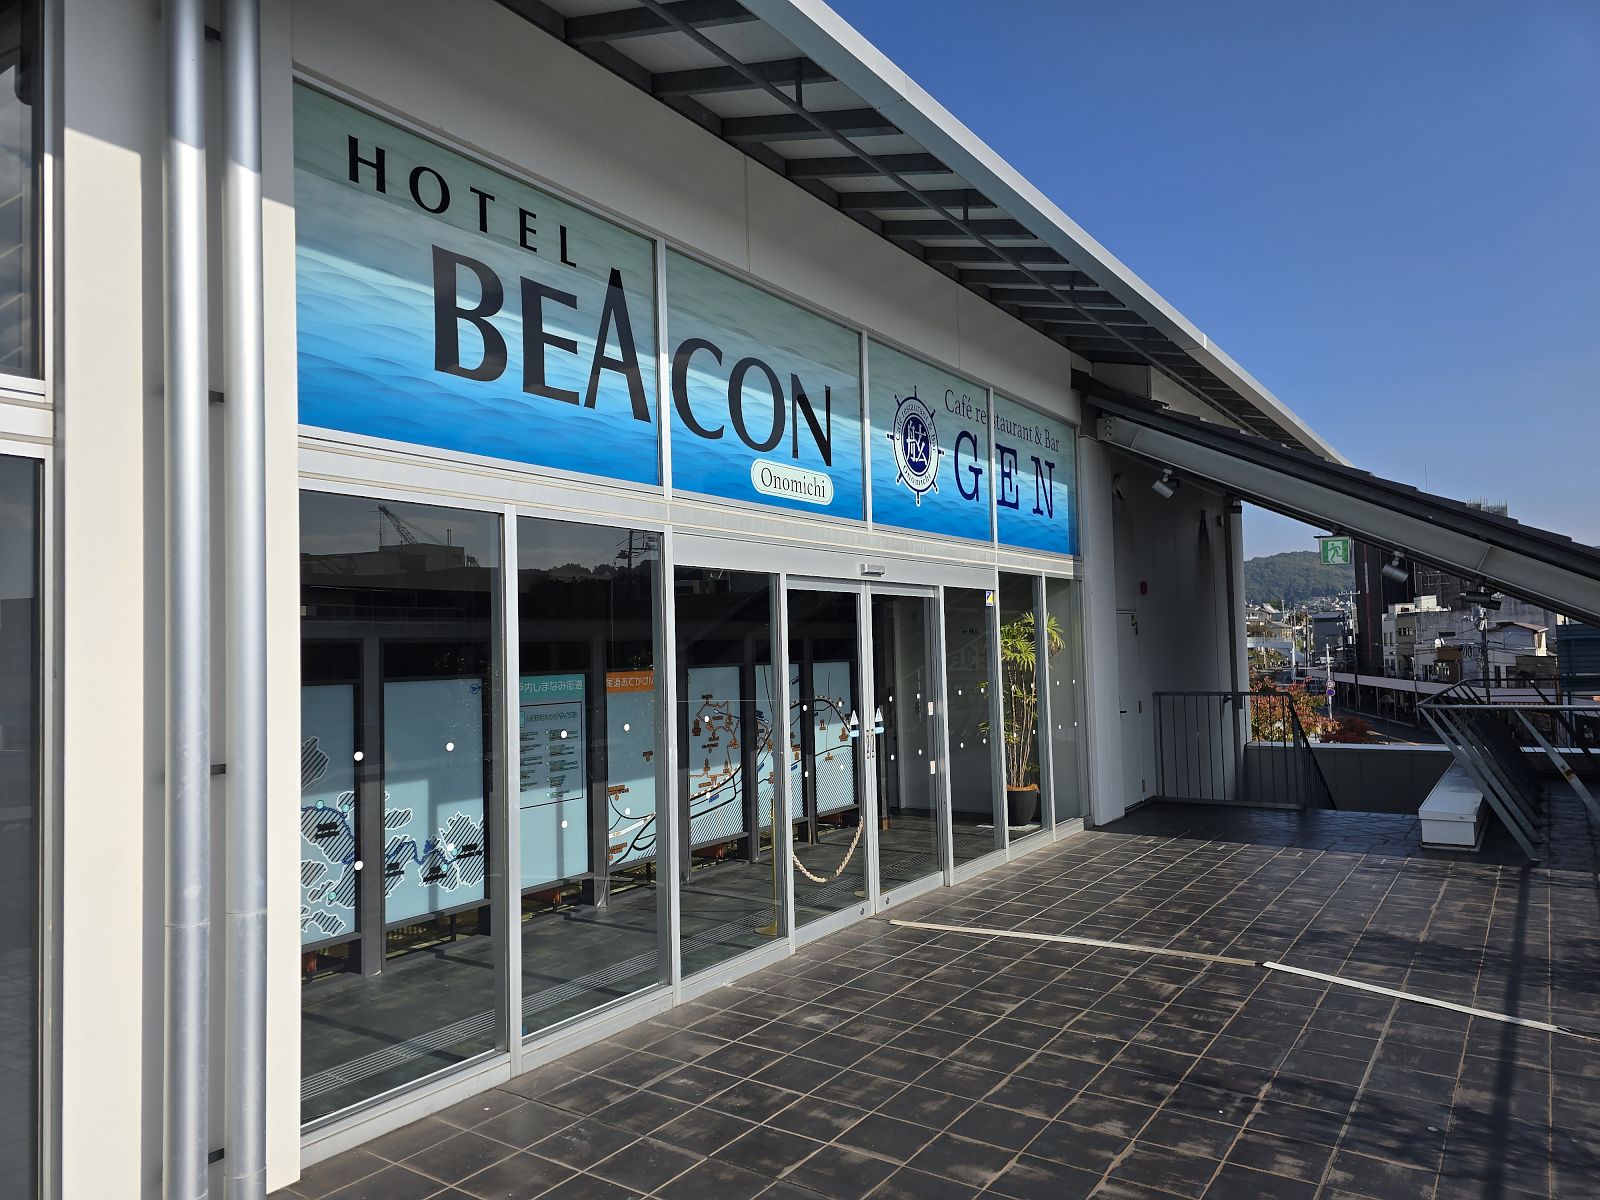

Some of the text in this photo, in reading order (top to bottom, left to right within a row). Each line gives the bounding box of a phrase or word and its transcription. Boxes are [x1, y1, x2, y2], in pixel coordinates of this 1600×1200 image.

[348, 134, 577, 268] HOTEL
[431, 244, 832, 467] BEACON
[944, 389, 1060, 453] Café retaurant & Bar
[760, 467, 826, 498] Onomichi
[954, 430, 1056, 519] GEN
